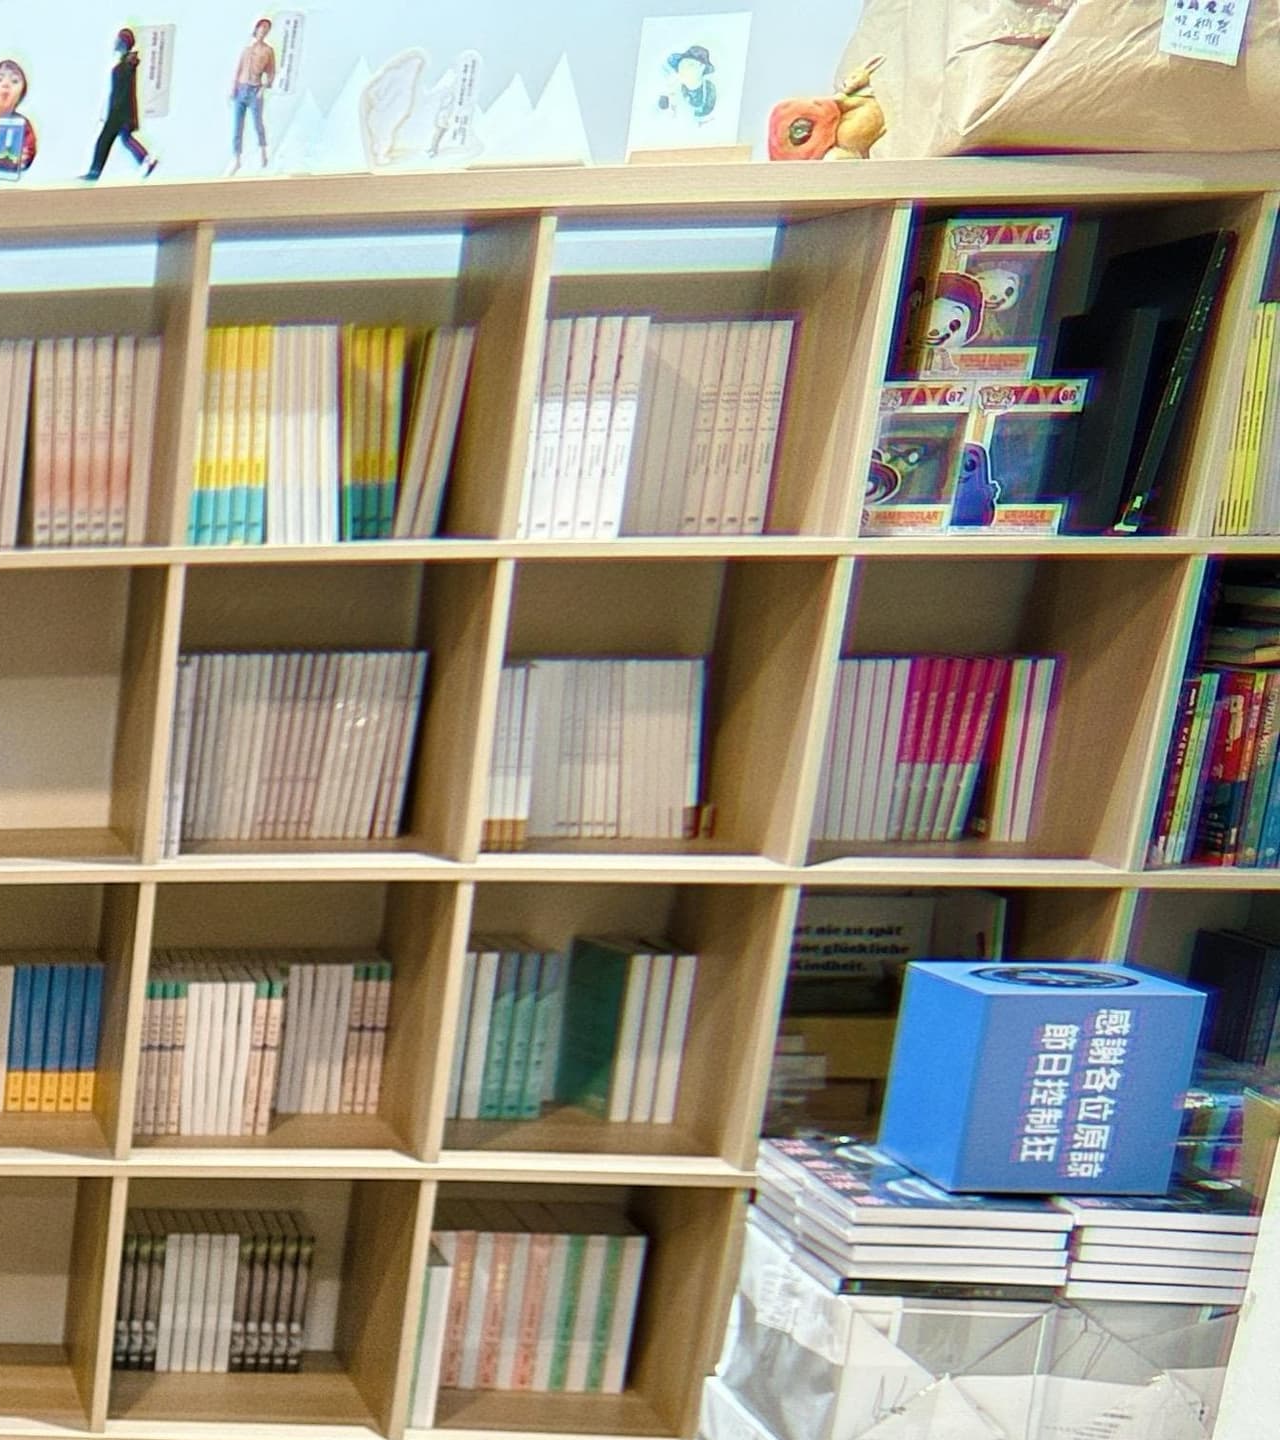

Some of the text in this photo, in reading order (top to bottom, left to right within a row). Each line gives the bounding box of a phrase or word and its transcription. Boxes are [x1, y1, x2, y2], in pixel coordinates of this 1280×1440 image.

[1019, 1023, 1081, 1163] 節日控制狂
[1066, 1008, 1132, 1179] 感謝各位原諒
